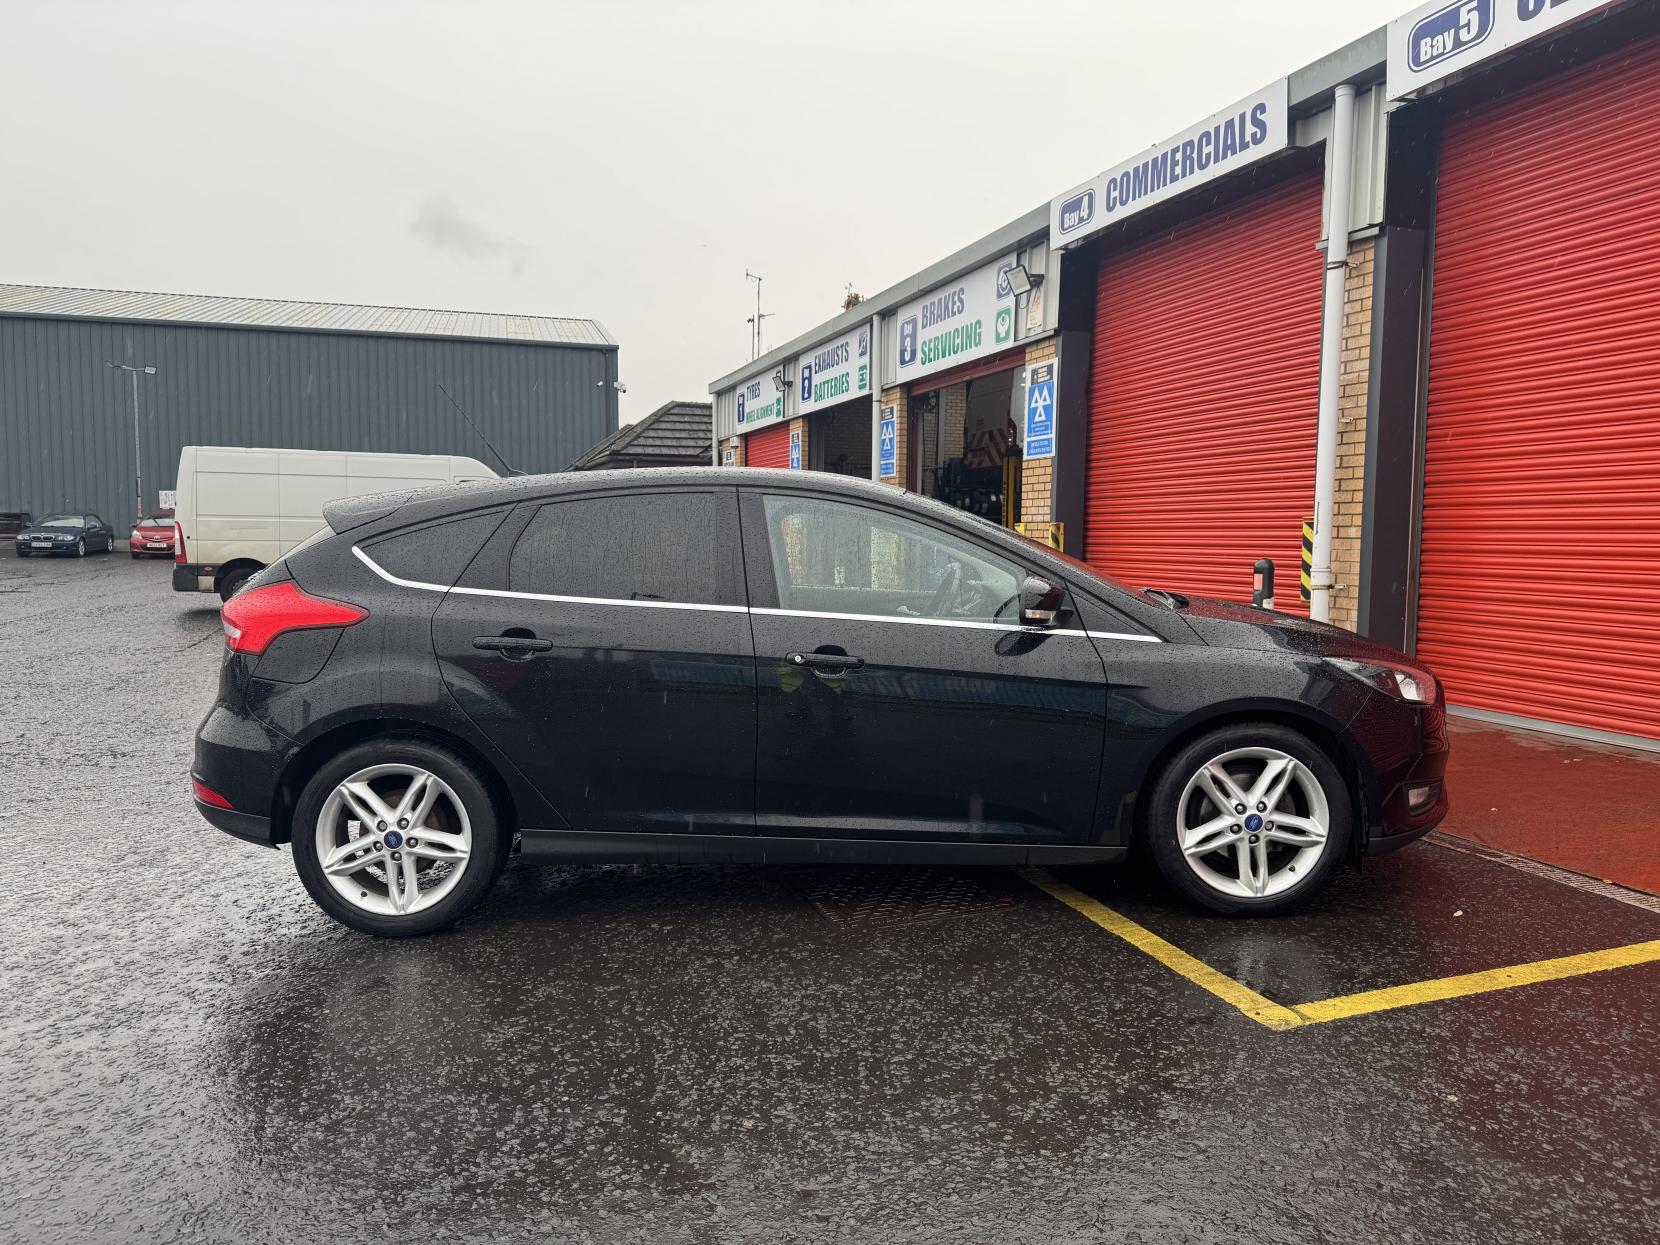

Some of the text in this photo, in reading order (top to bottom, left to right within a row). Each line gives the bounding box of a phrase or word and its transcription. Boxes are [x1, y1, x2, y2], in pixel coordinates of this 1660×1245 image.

[1420, 28, 1455, 62] Bay
[1459, 1, 1479, 42] 5
[1105, 102, 1267, 213] COMMERCIALS
[1063, 194, 1089, 230] Bay 4
[921, 286, 965, 330] BRAKES
[814, 341, 849, 375] EXHAUSTS
[904, 337, 911, 362] 3
[920, 319, 982, 366] SERVICING
[803, 378, 809, 399] 2
[814, 371, 850, 403] BATTERIES
